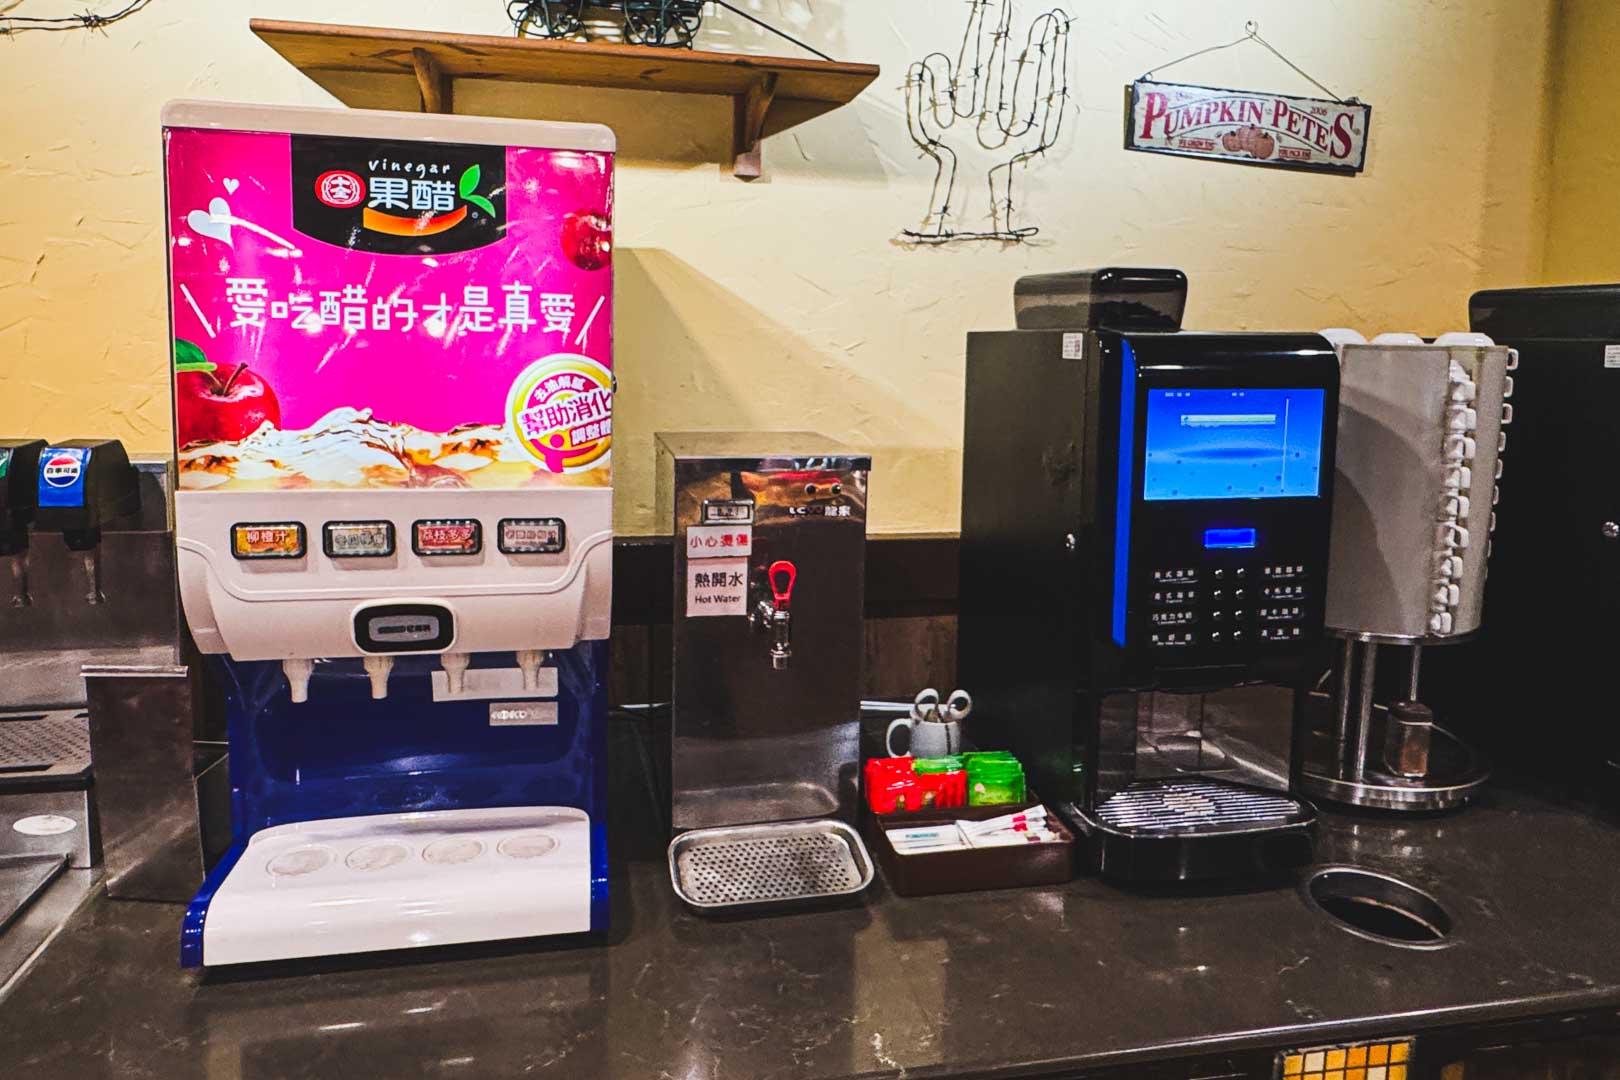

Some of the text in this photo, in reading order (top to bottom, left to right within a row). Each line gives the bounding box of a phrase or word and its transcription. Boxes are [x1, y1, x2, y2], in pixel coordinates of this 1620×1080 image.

[368, 158, 451, 179] vinegar
[367, 177, 456, 211] 果醋
[225, 277, 576, 334] 愛吃醋的才是真愛
[246, 529, 290, 545] 柳橙汁
[422, 527, 473, 541] 荔枝多多
[690, 534, 749, 549] 小心燙傷
[694, 571, 744, 589] 熱開水
[694, 594, 741, 604] Hot Water
